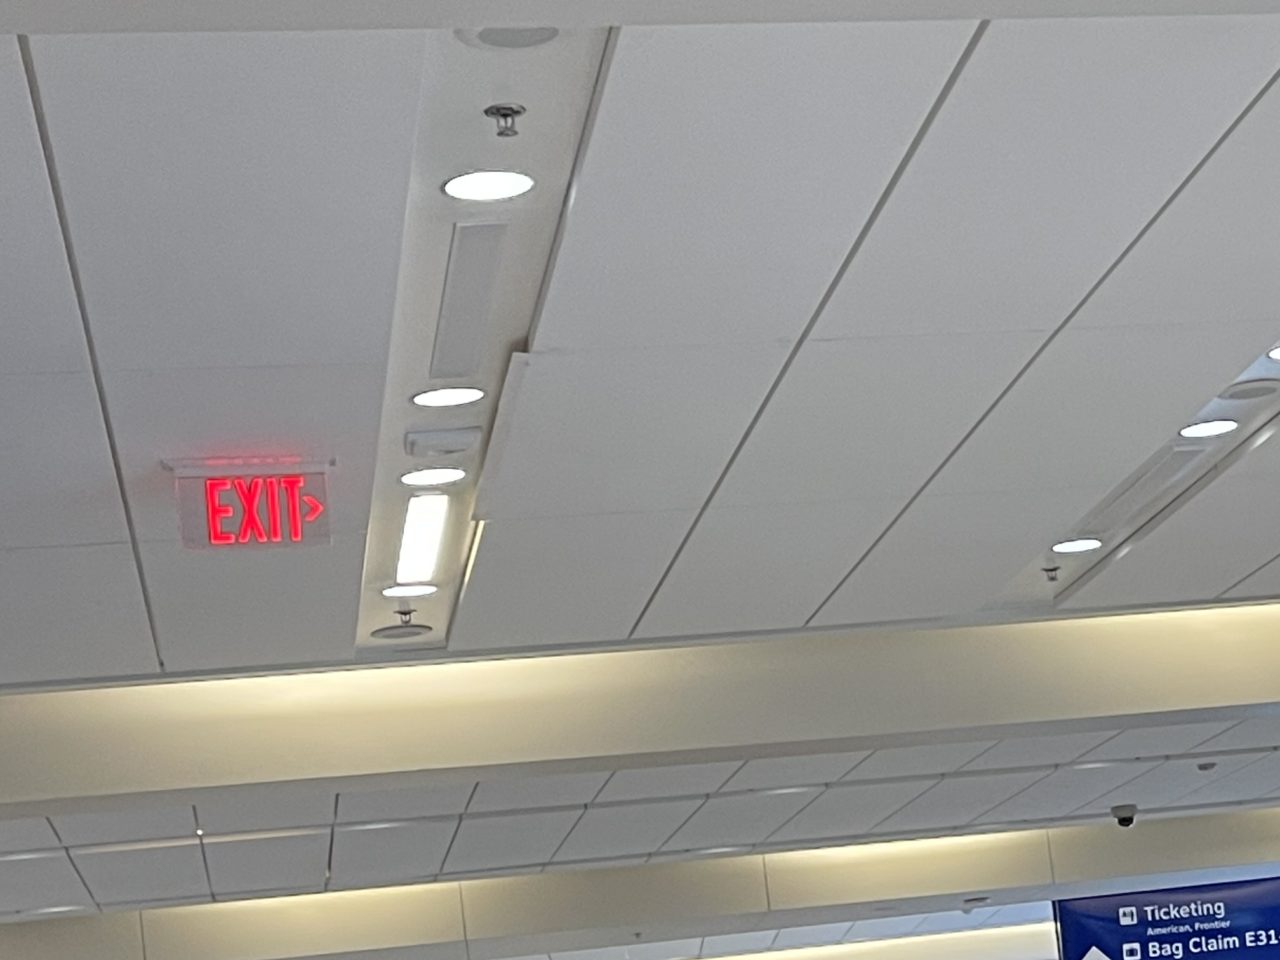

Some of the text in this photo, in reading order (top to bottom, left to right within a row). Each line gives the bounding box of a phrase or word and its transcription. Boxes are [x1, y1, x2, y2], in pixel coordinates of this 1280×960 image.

[205, 476, 304, 545] EXIT
[1144, 901, 1226, 922] Ticketing
[1147, 920, 1231, 936] American, Frontier
[1148, 941, 1183, 959] Bag
[1189, 935, 1240, 953] Claim
